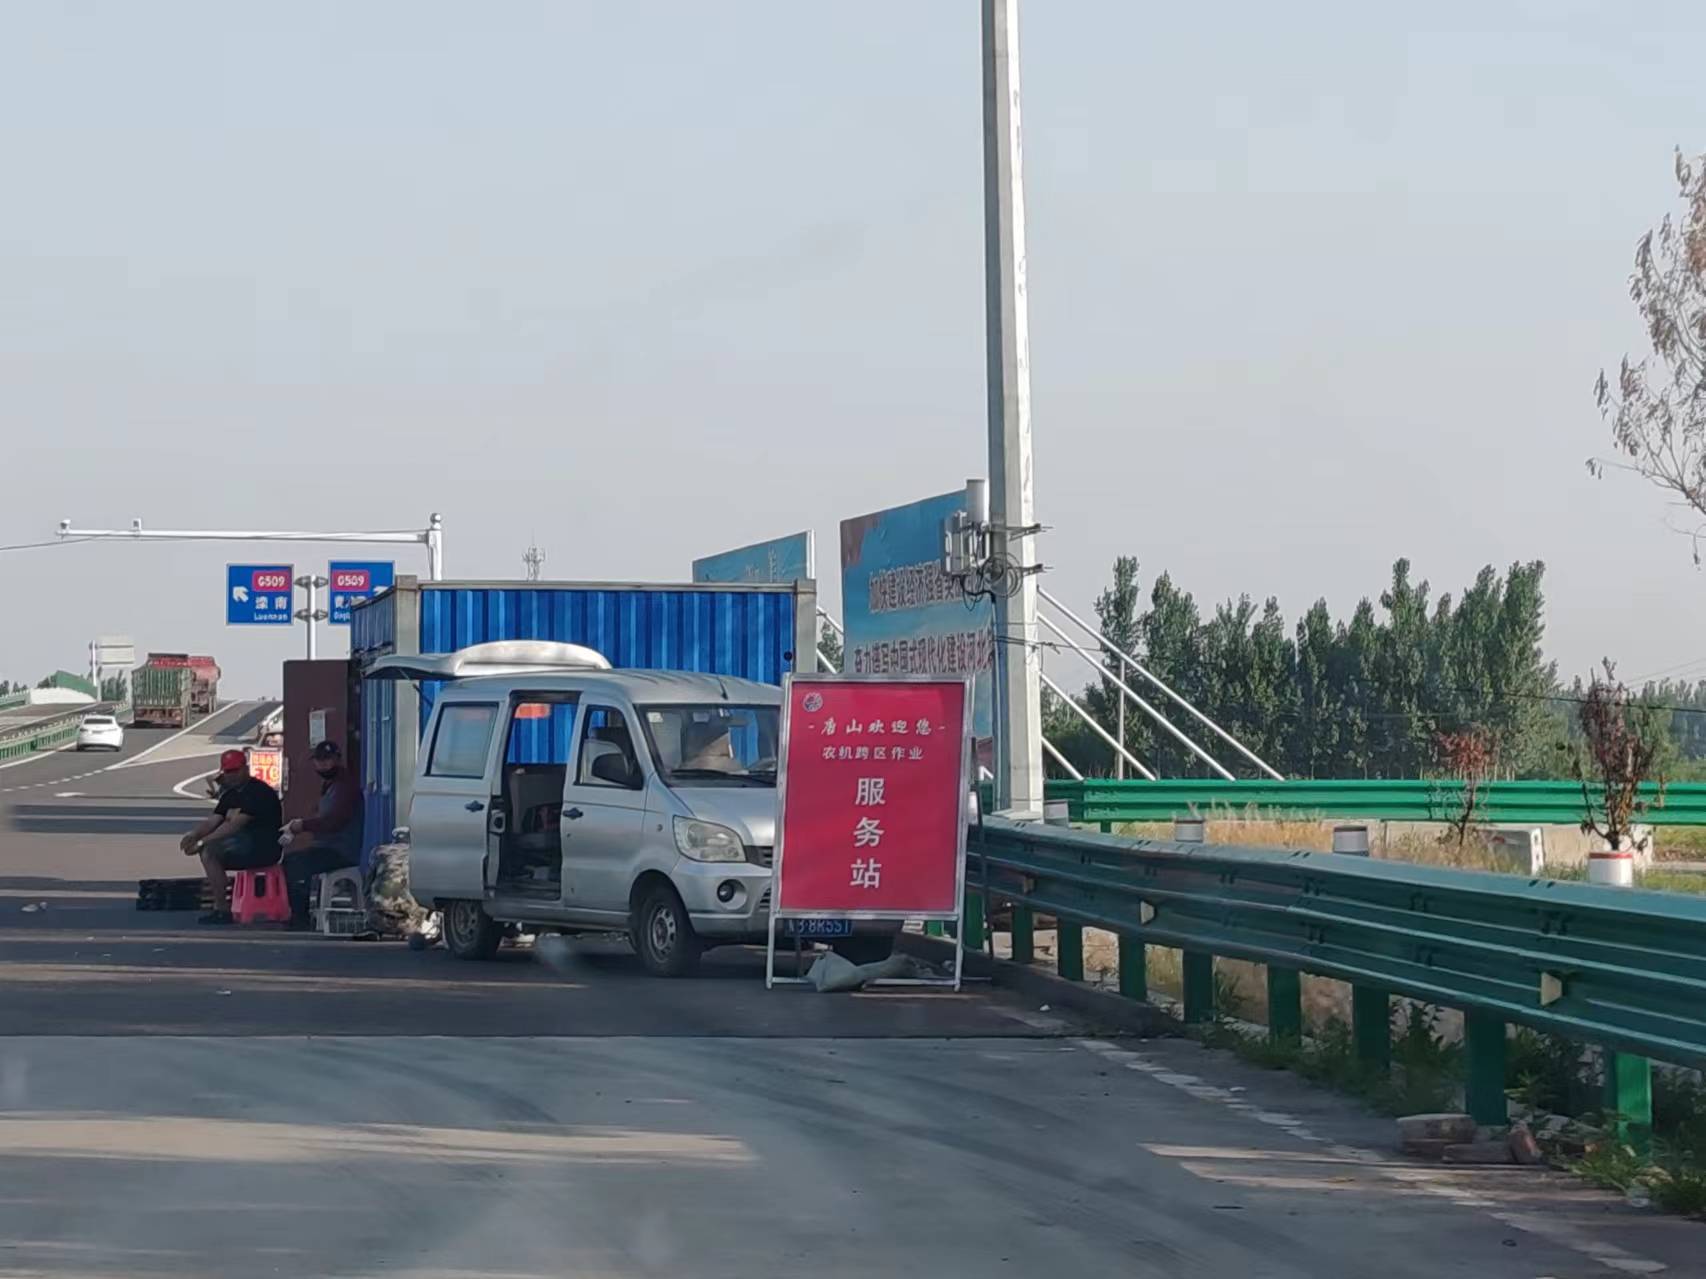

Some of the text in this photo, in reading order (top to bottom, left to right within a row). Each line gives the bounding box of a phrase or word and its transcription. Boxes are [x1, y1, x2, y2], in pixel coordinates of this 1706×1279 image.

[258, 575, 285, 587] G509
[337, 575, 365, 587] G509
[822, 746, 924, 760] 农机跨区作业
[849, 777, 886, 889] 服务站
